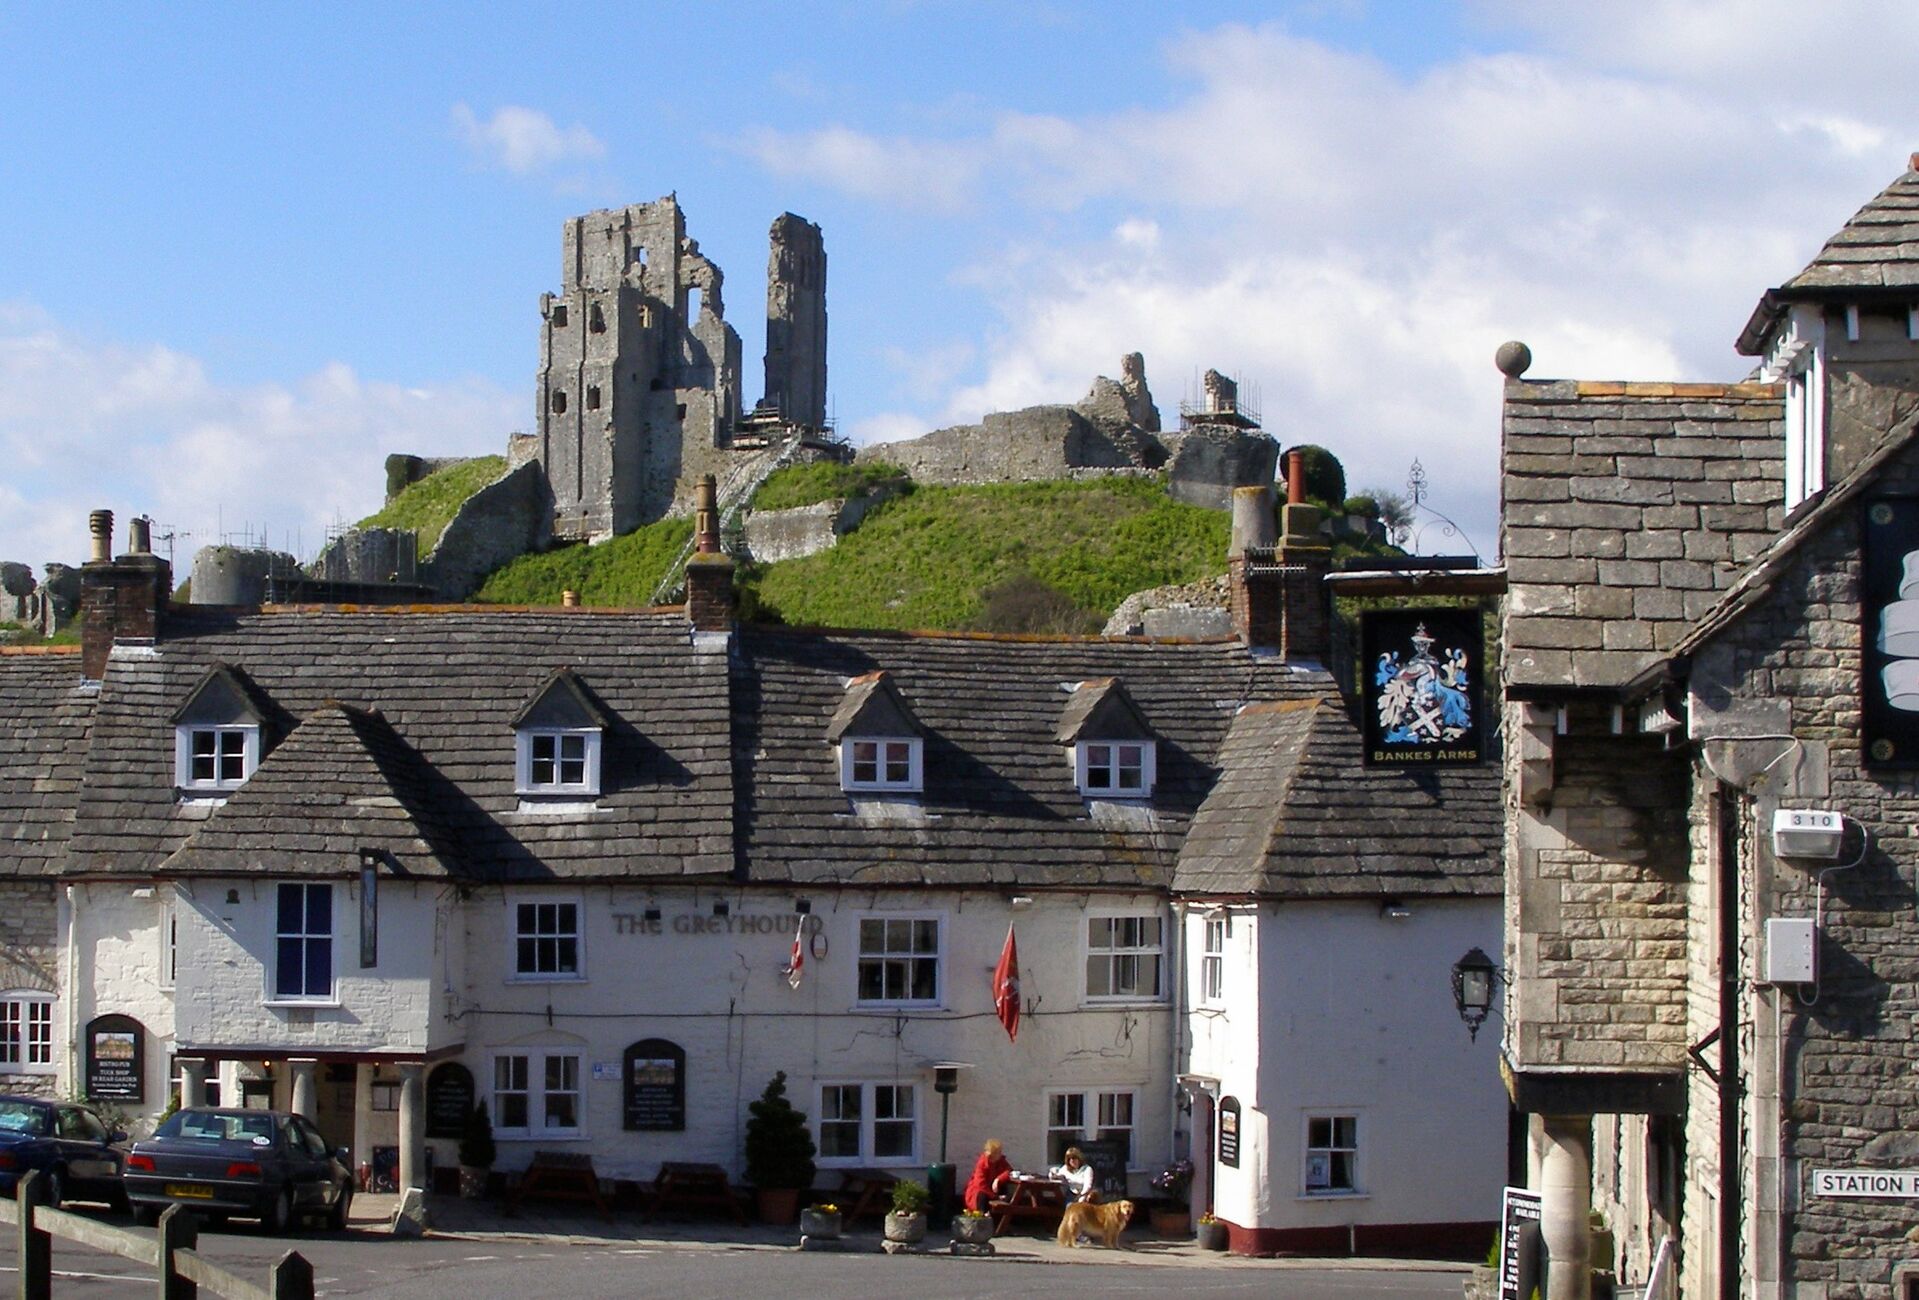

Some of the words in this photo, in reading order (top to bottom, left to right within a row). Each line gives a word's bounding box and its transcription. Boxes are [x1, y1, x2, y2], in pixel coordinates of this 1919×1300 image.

[1374, 751, 1432, 761] BANKES
[1437, 750, 1477, 760] ARMS
[611, 913, 662, 935] THE
[673, 913, 823, 936] GREYHOUND
[1823, 1175, 1903, 1192] STATION
